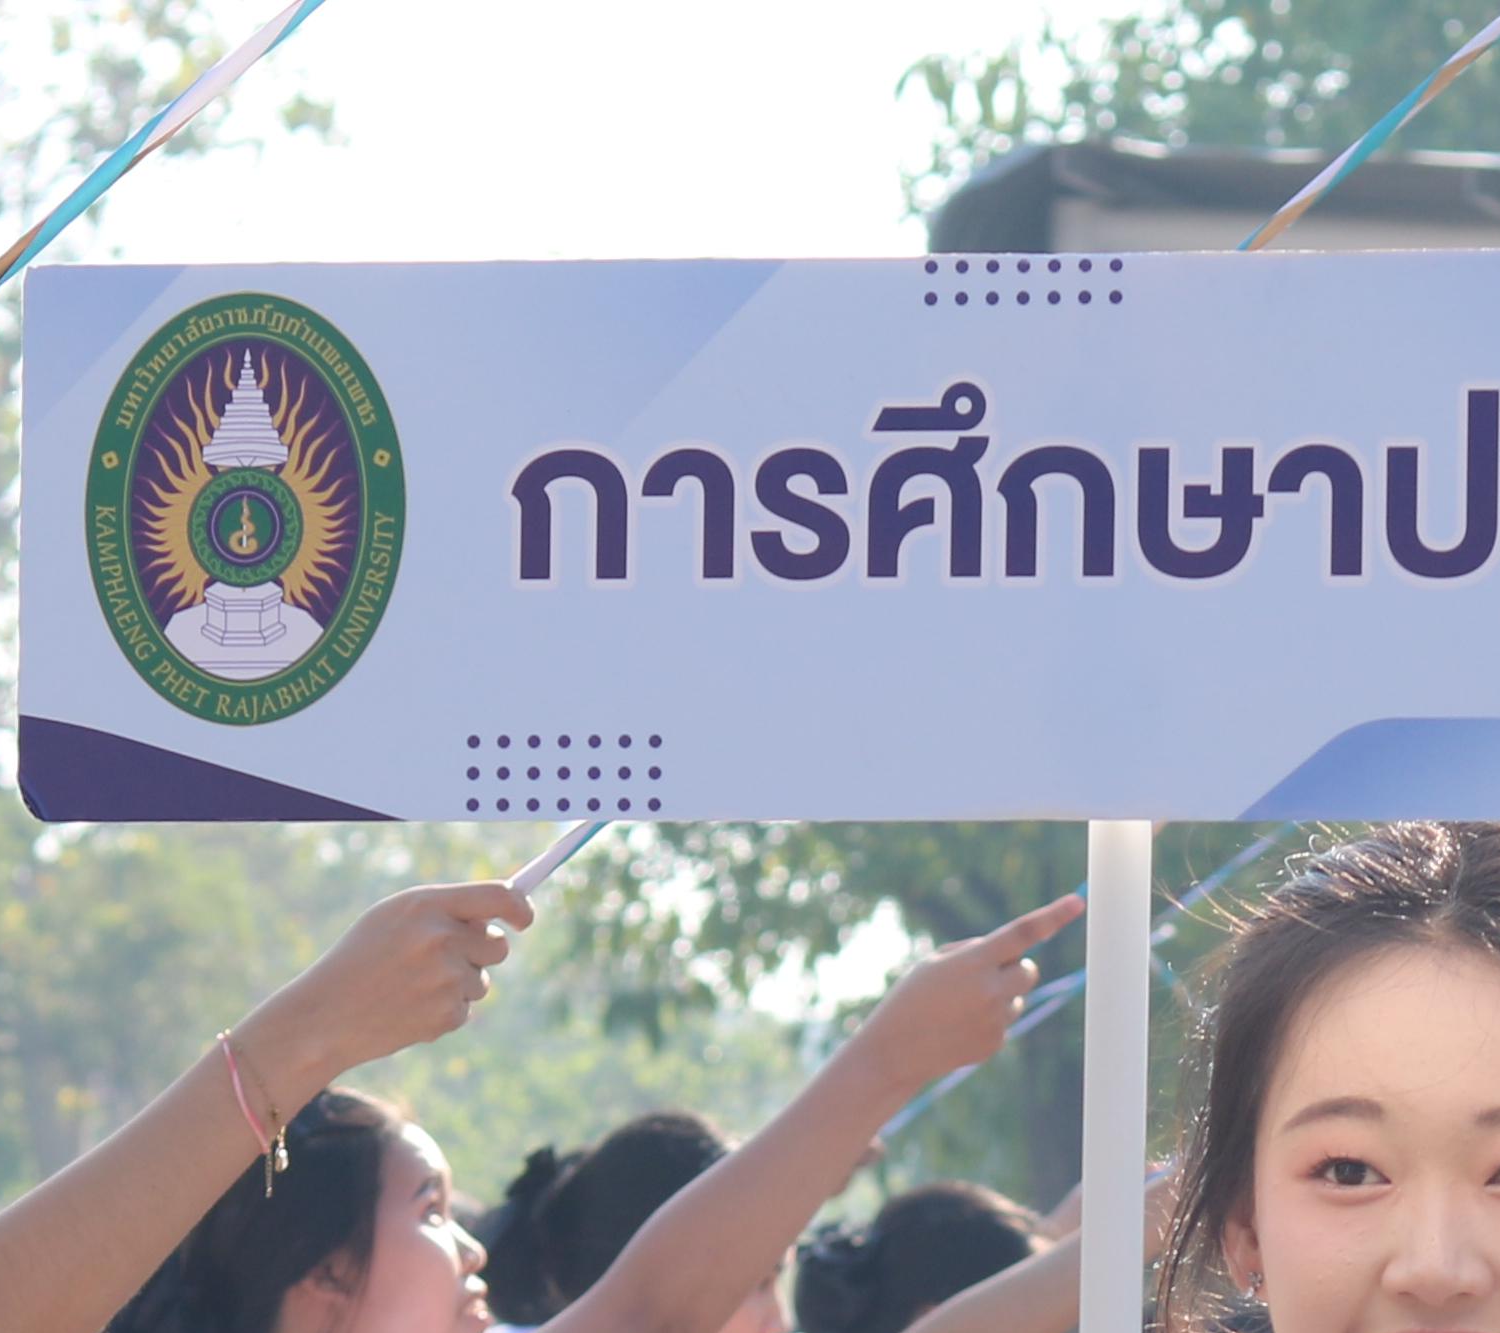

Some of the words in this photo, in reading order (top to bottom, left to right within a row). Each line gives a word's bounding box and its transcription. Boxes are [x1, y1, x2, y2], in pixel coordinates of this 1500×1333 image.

[94, 504, 157, 661] KAMPHAENG
[152, 660, 210, 708] PHET
[215, 655, 336, 723] RAJABHAT
[332, 511, 395, 658] UNIVERSITY
